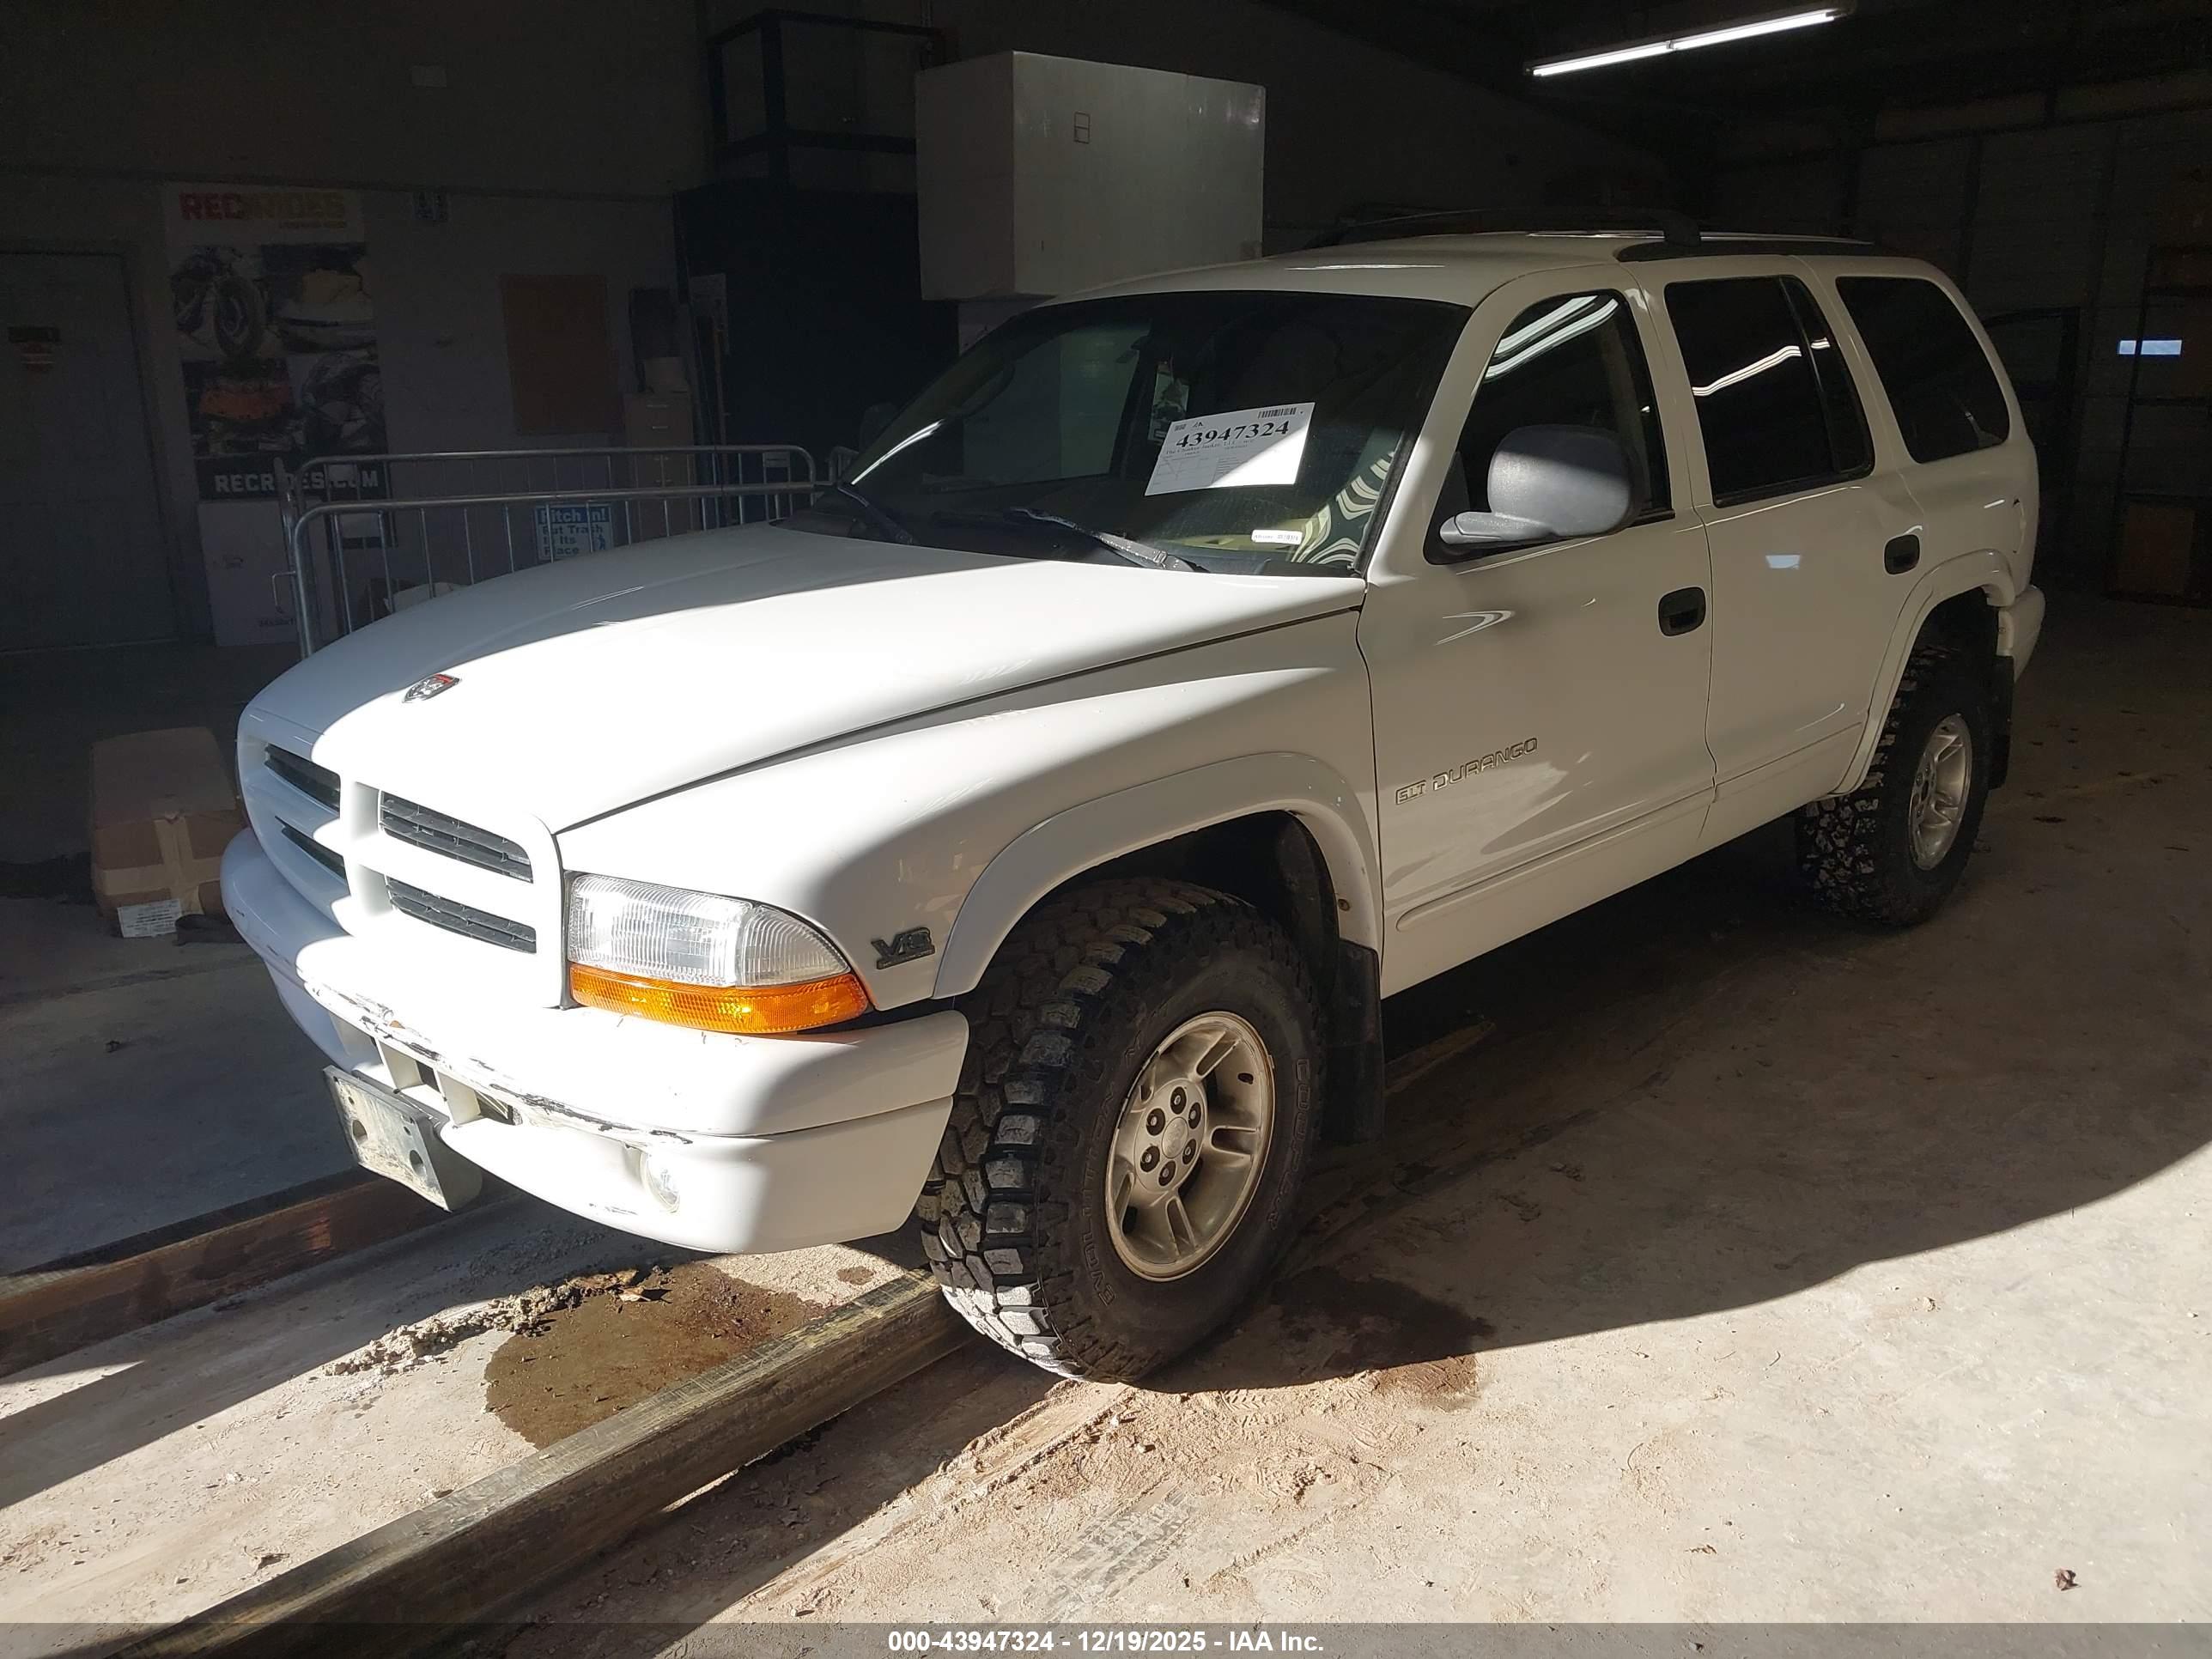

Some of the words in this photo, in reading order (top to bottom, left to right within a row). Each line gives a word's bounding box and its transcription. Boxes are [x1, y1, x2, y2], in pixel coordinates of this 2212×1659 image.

[1176, 420, 1290, 448] 43947324
[586, 507, 605, 523] n!
[544, 547, 578, 556] Pace
[1396, 781, 1426, 804] SLT
[1432, 737, 1538, 791] DURANGO
